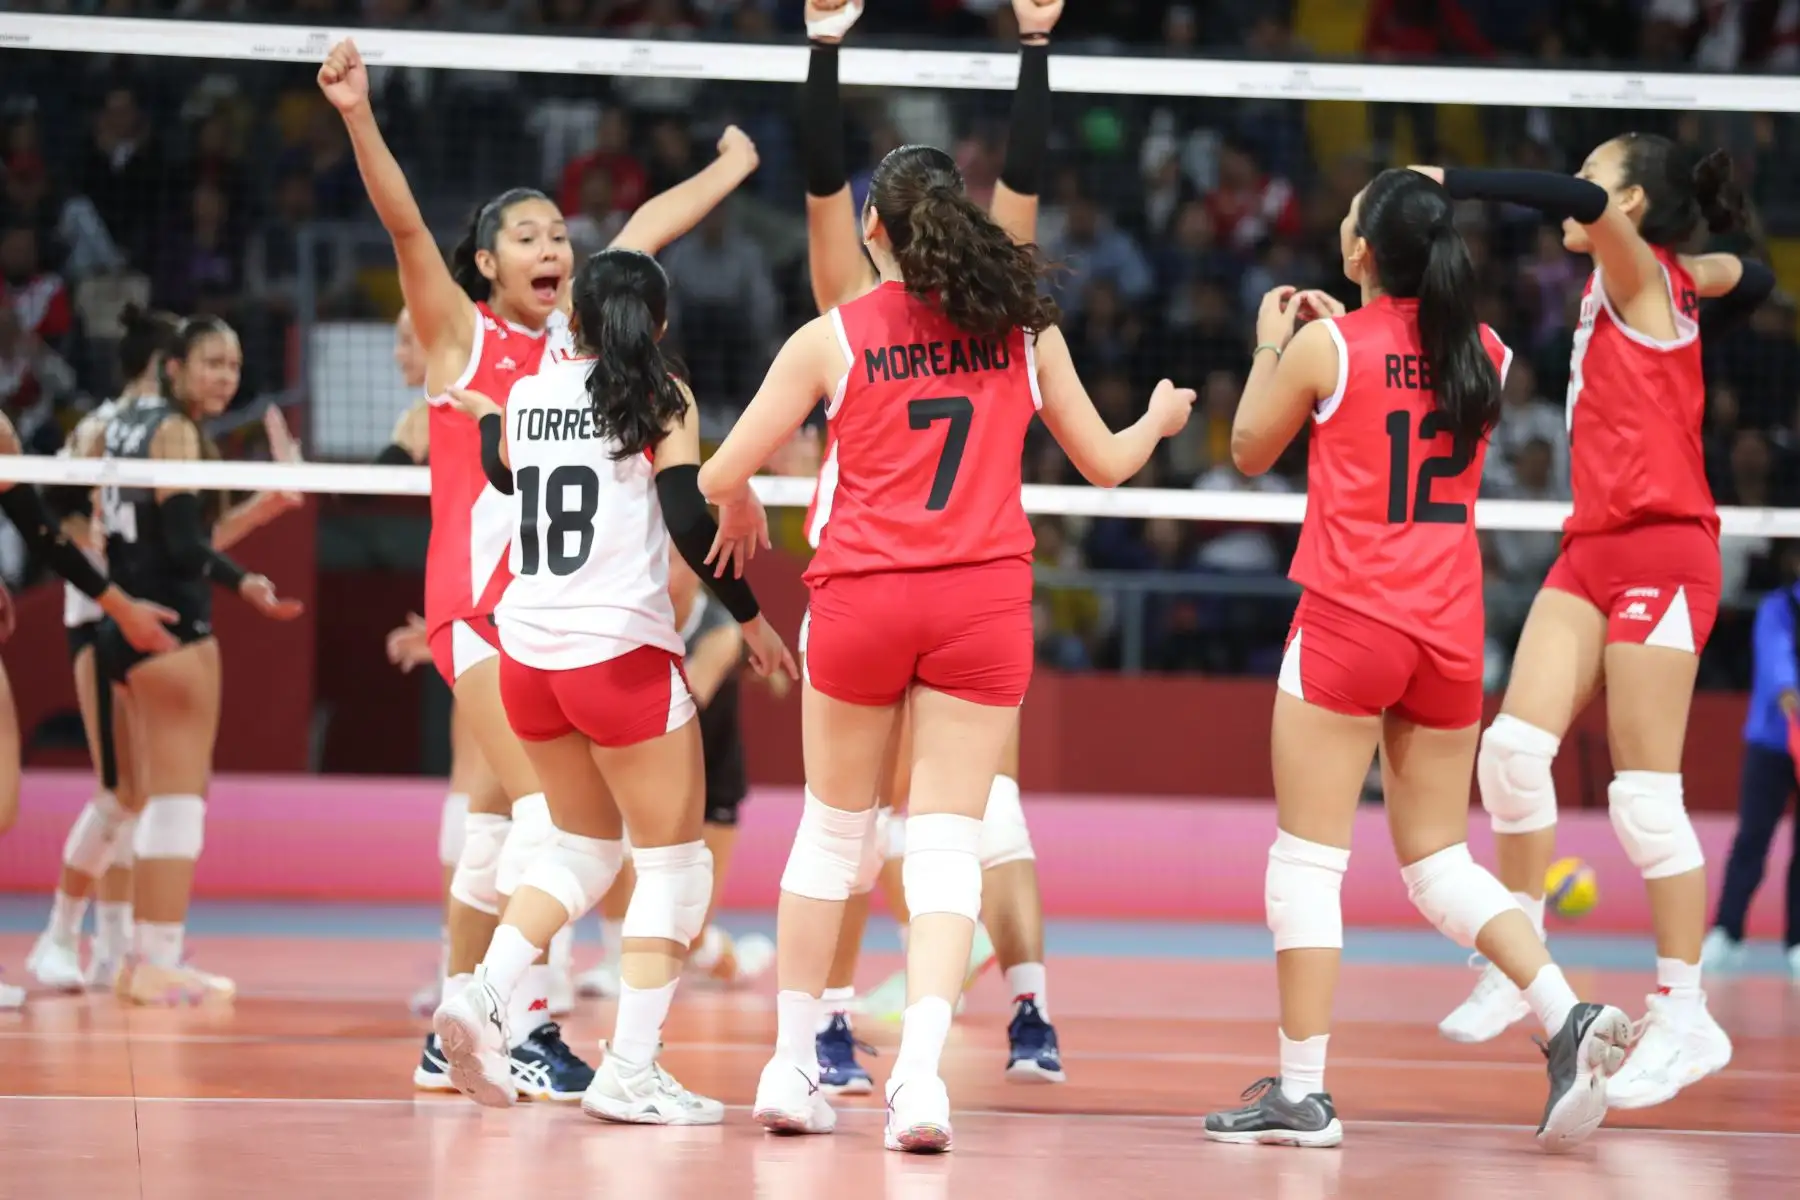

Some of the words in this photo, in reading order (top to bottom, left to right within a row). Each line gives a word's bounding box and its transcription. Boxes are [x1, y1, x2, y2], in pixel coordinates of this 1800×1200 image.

[865, 338, 1010, 384] MOREANO
[908, 396, 974, 511] 7
[1386, 410, 1476, 524] 12
[516, 465, 599, 576] 18
